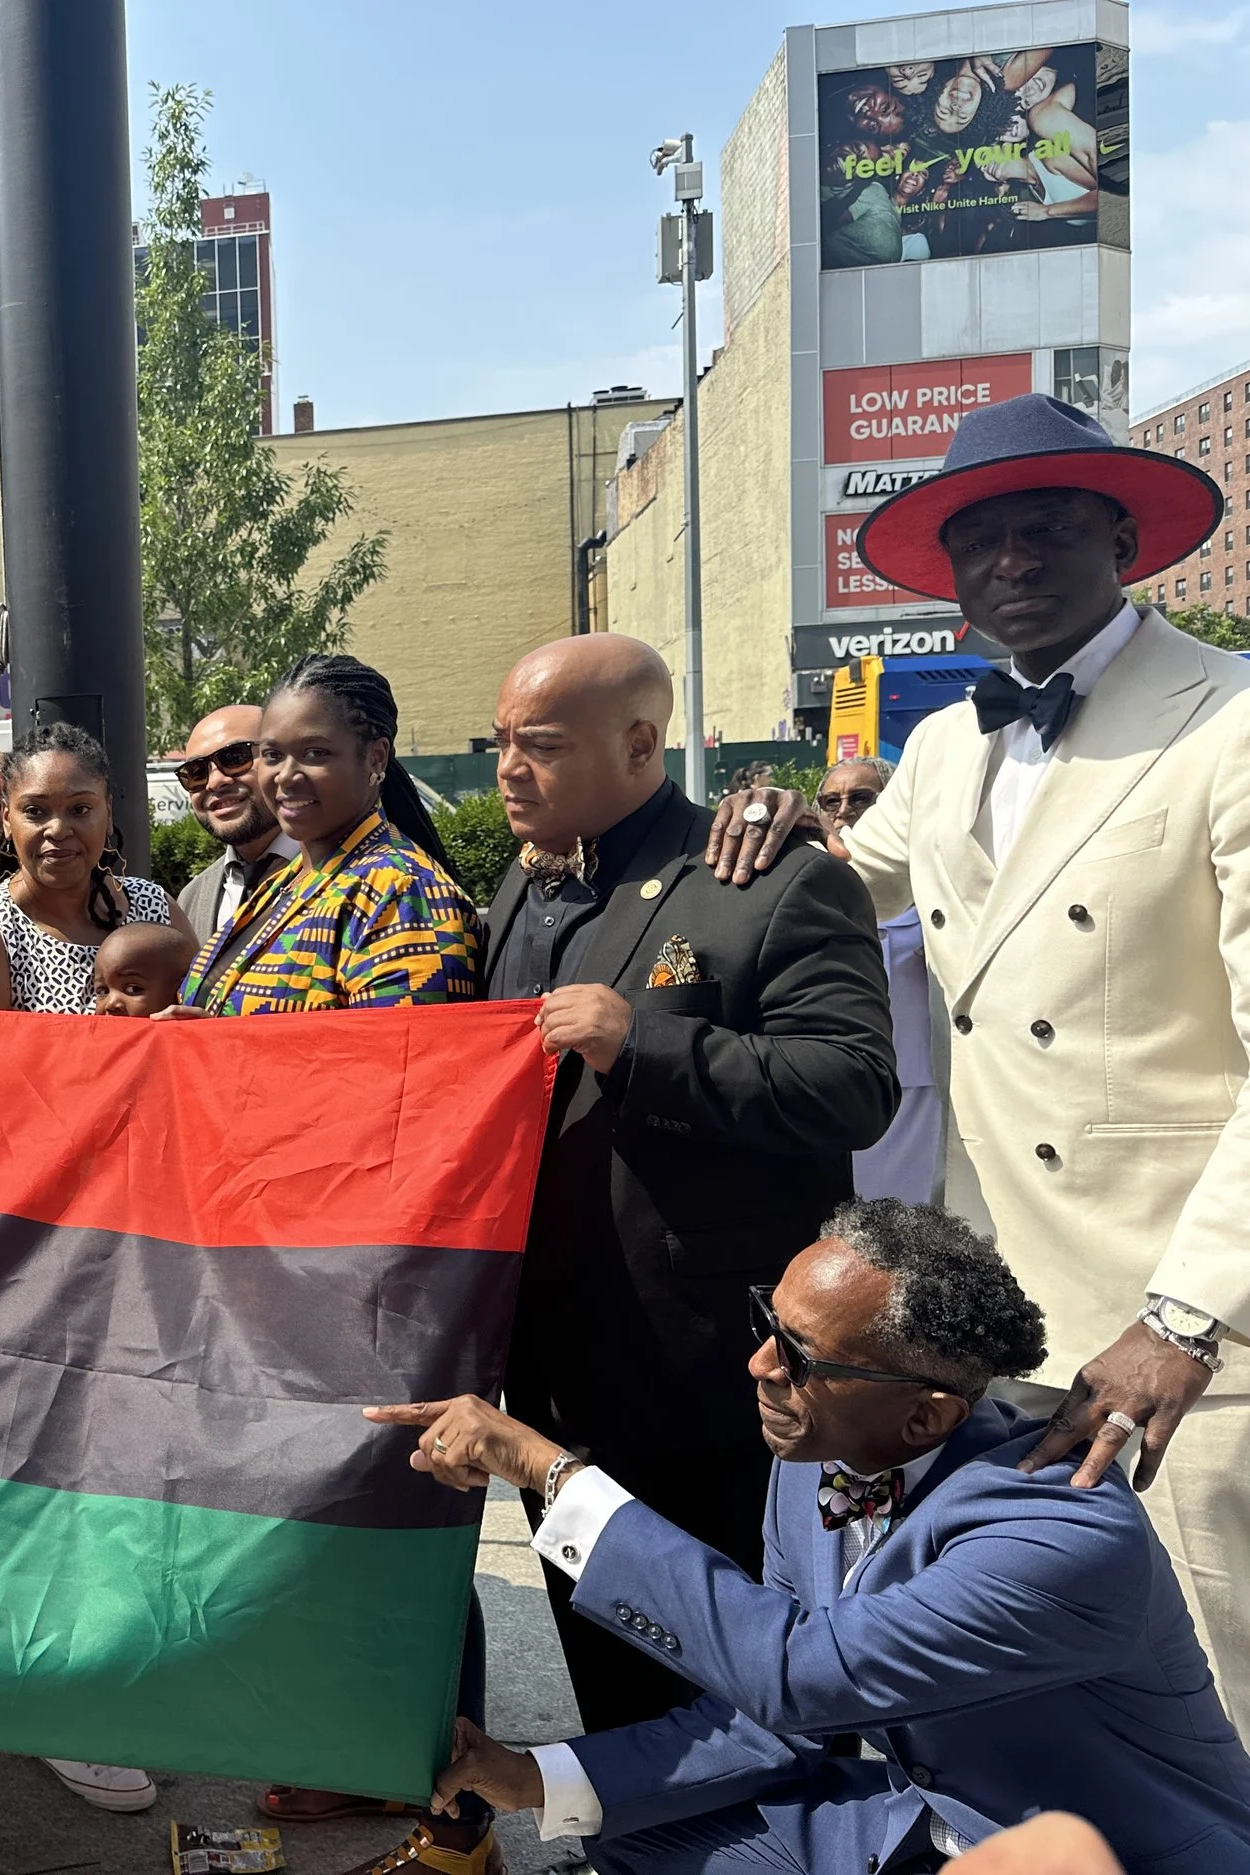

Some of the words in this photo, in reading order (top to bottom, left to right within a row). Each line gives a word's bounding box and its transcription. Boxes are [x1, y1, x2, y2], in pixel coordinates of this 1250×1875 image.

[843, 149, 903, 180] feel
[955, 141, 1027, 175] your
[1034, 130, 1071, 160] all
[896, 204, 920, 215] Visit
[921, 201, 946, 211] Nike
[947, 198, 977, 209] Unite
[978, 194, 1019, 206] Harlem
[849, 389, 909, 414] LOW
[916, 382, 991, 408] PRICE
[849, 411, 970, 440] GUARAN
[829, 627, 956, 659] verizon
[155, 797, 189, 812] ervi
